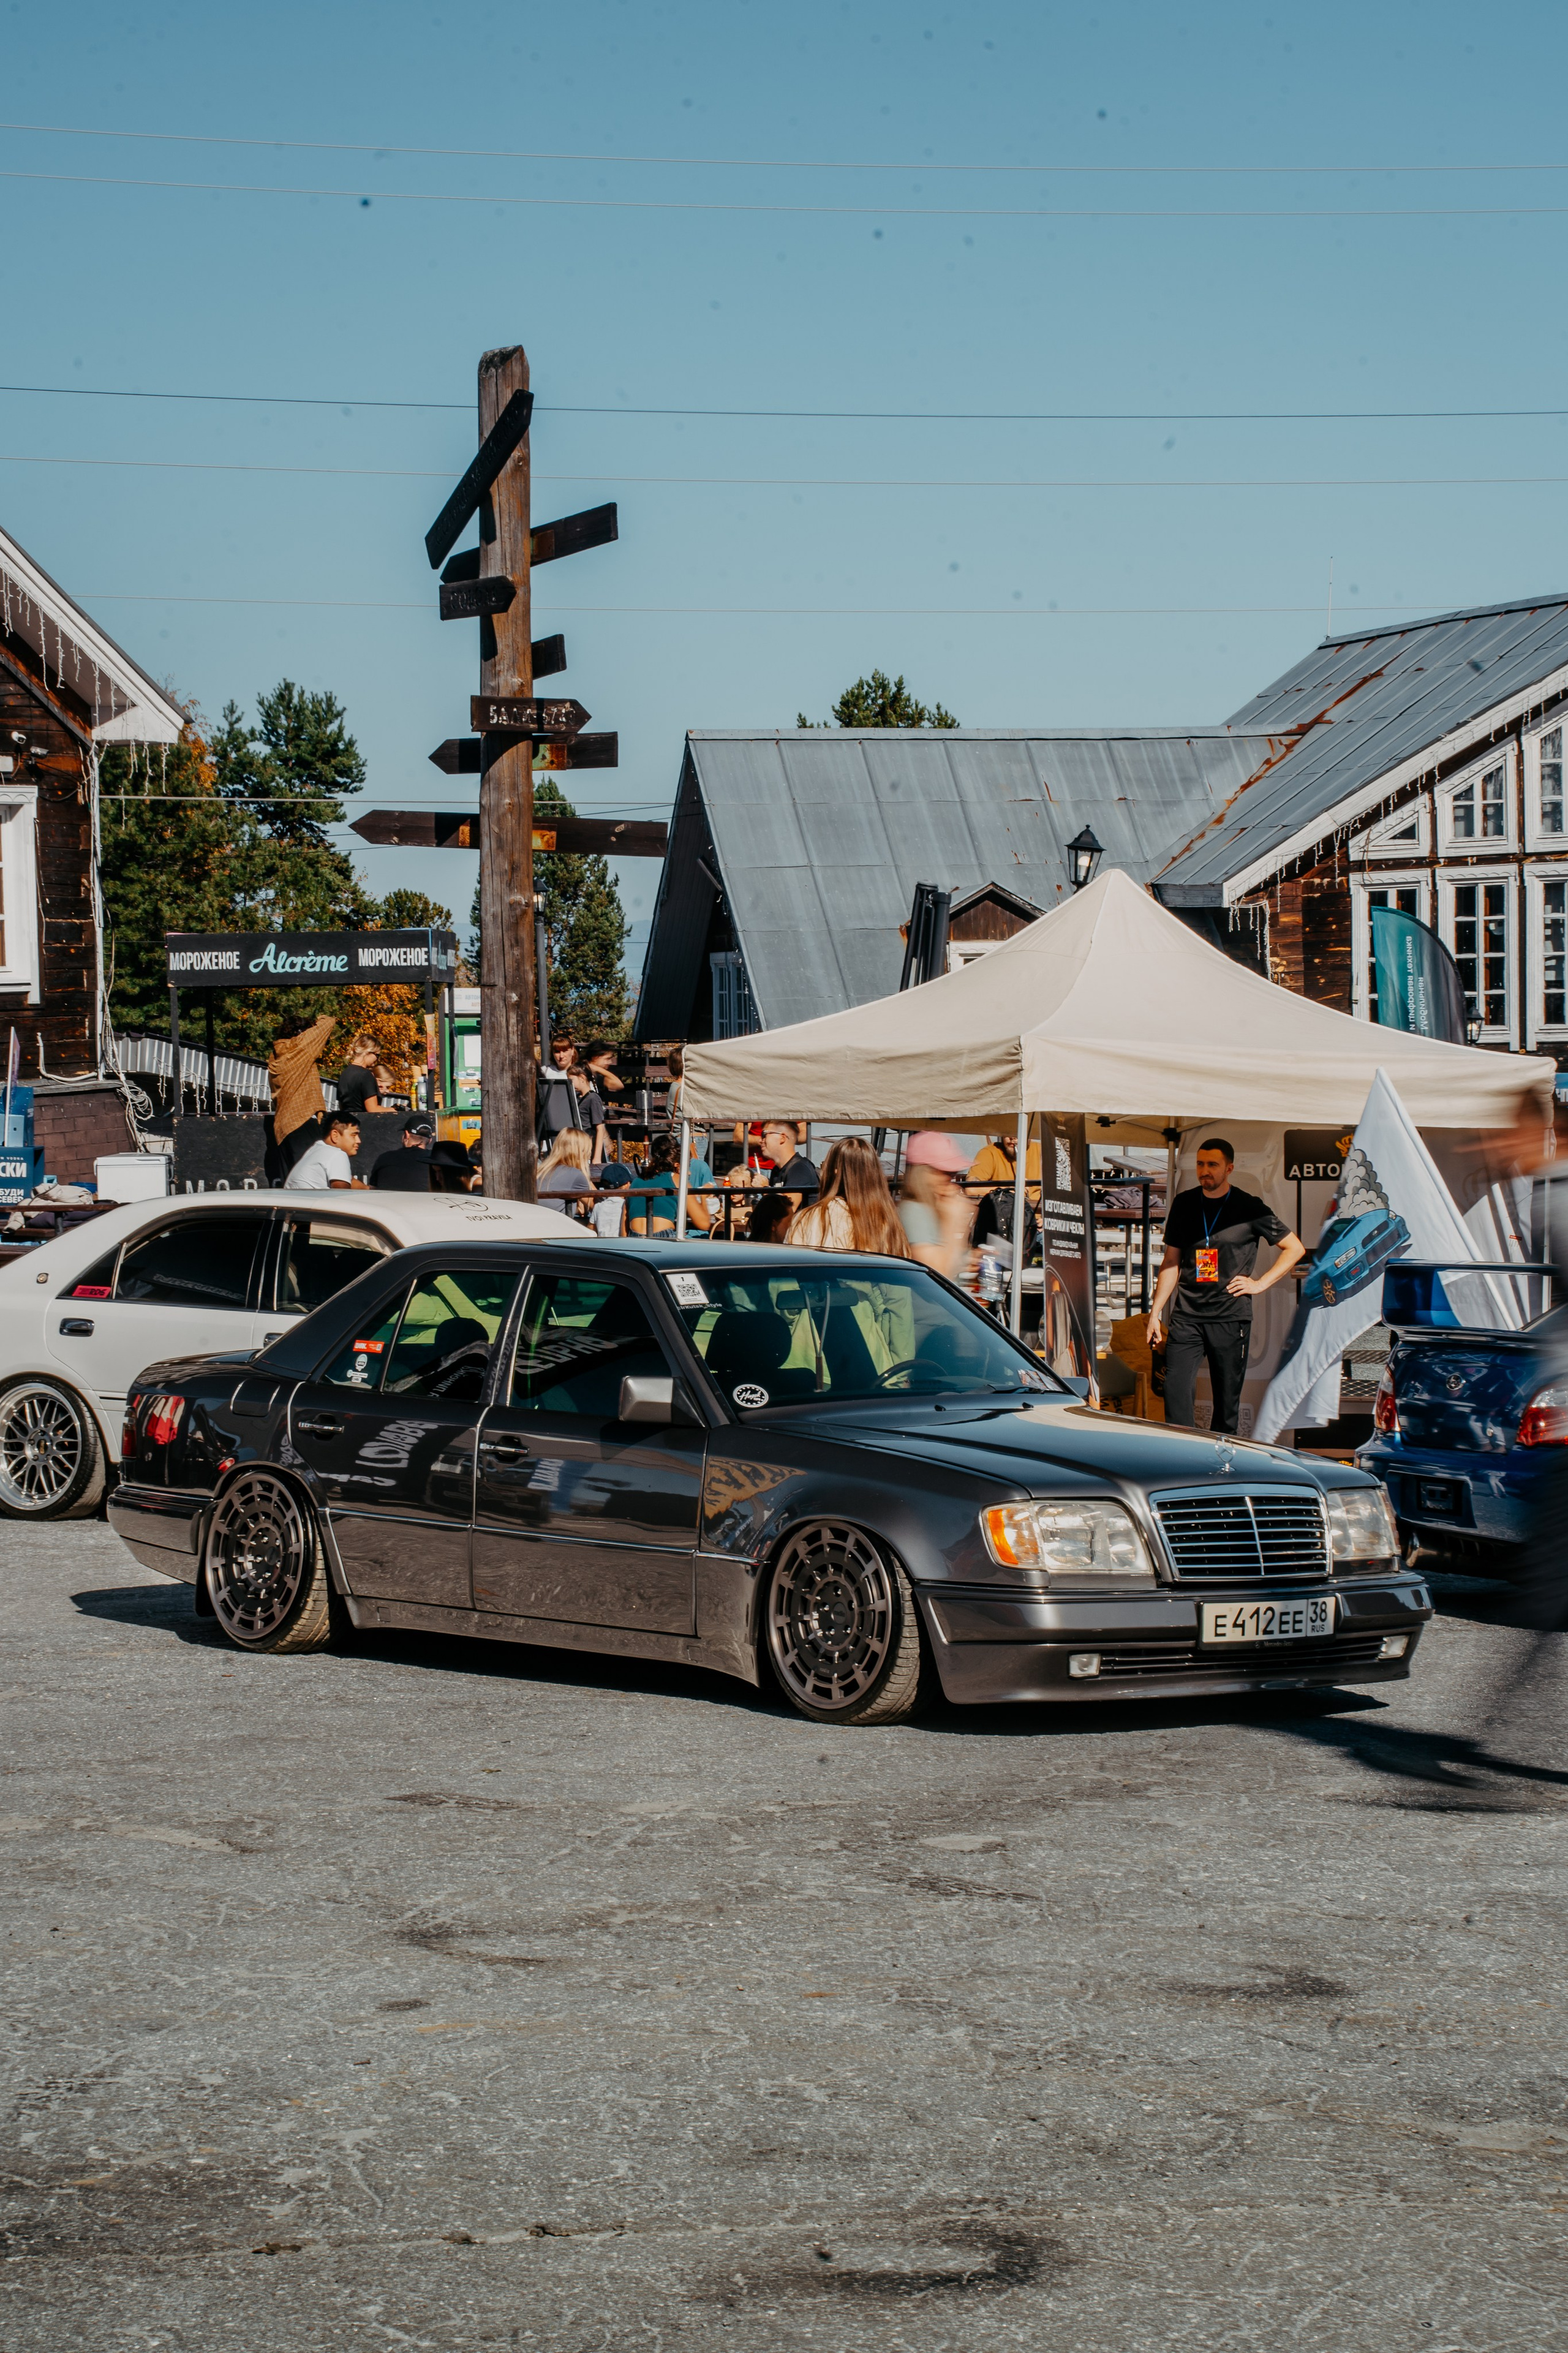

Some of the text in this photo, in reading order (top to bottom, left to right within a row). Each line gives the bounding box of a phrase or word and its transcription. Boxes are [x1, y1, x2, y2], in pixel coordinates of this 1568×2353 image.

[169, 951, 240, 970] МОРОЖЕНОЕ
[358, 948, 429, 966] МОРОЖЕНОЕ
[1045, 1199, 1082, 1217] ИЗГОТАВЛИВАЕМ
[1044, 1218, 1066, 1232] КОВРИКИ
[1215, 1601, 1328, 1637] Е412ЕЕ 38
[1311, 1624, 1325, 1633] RUS
